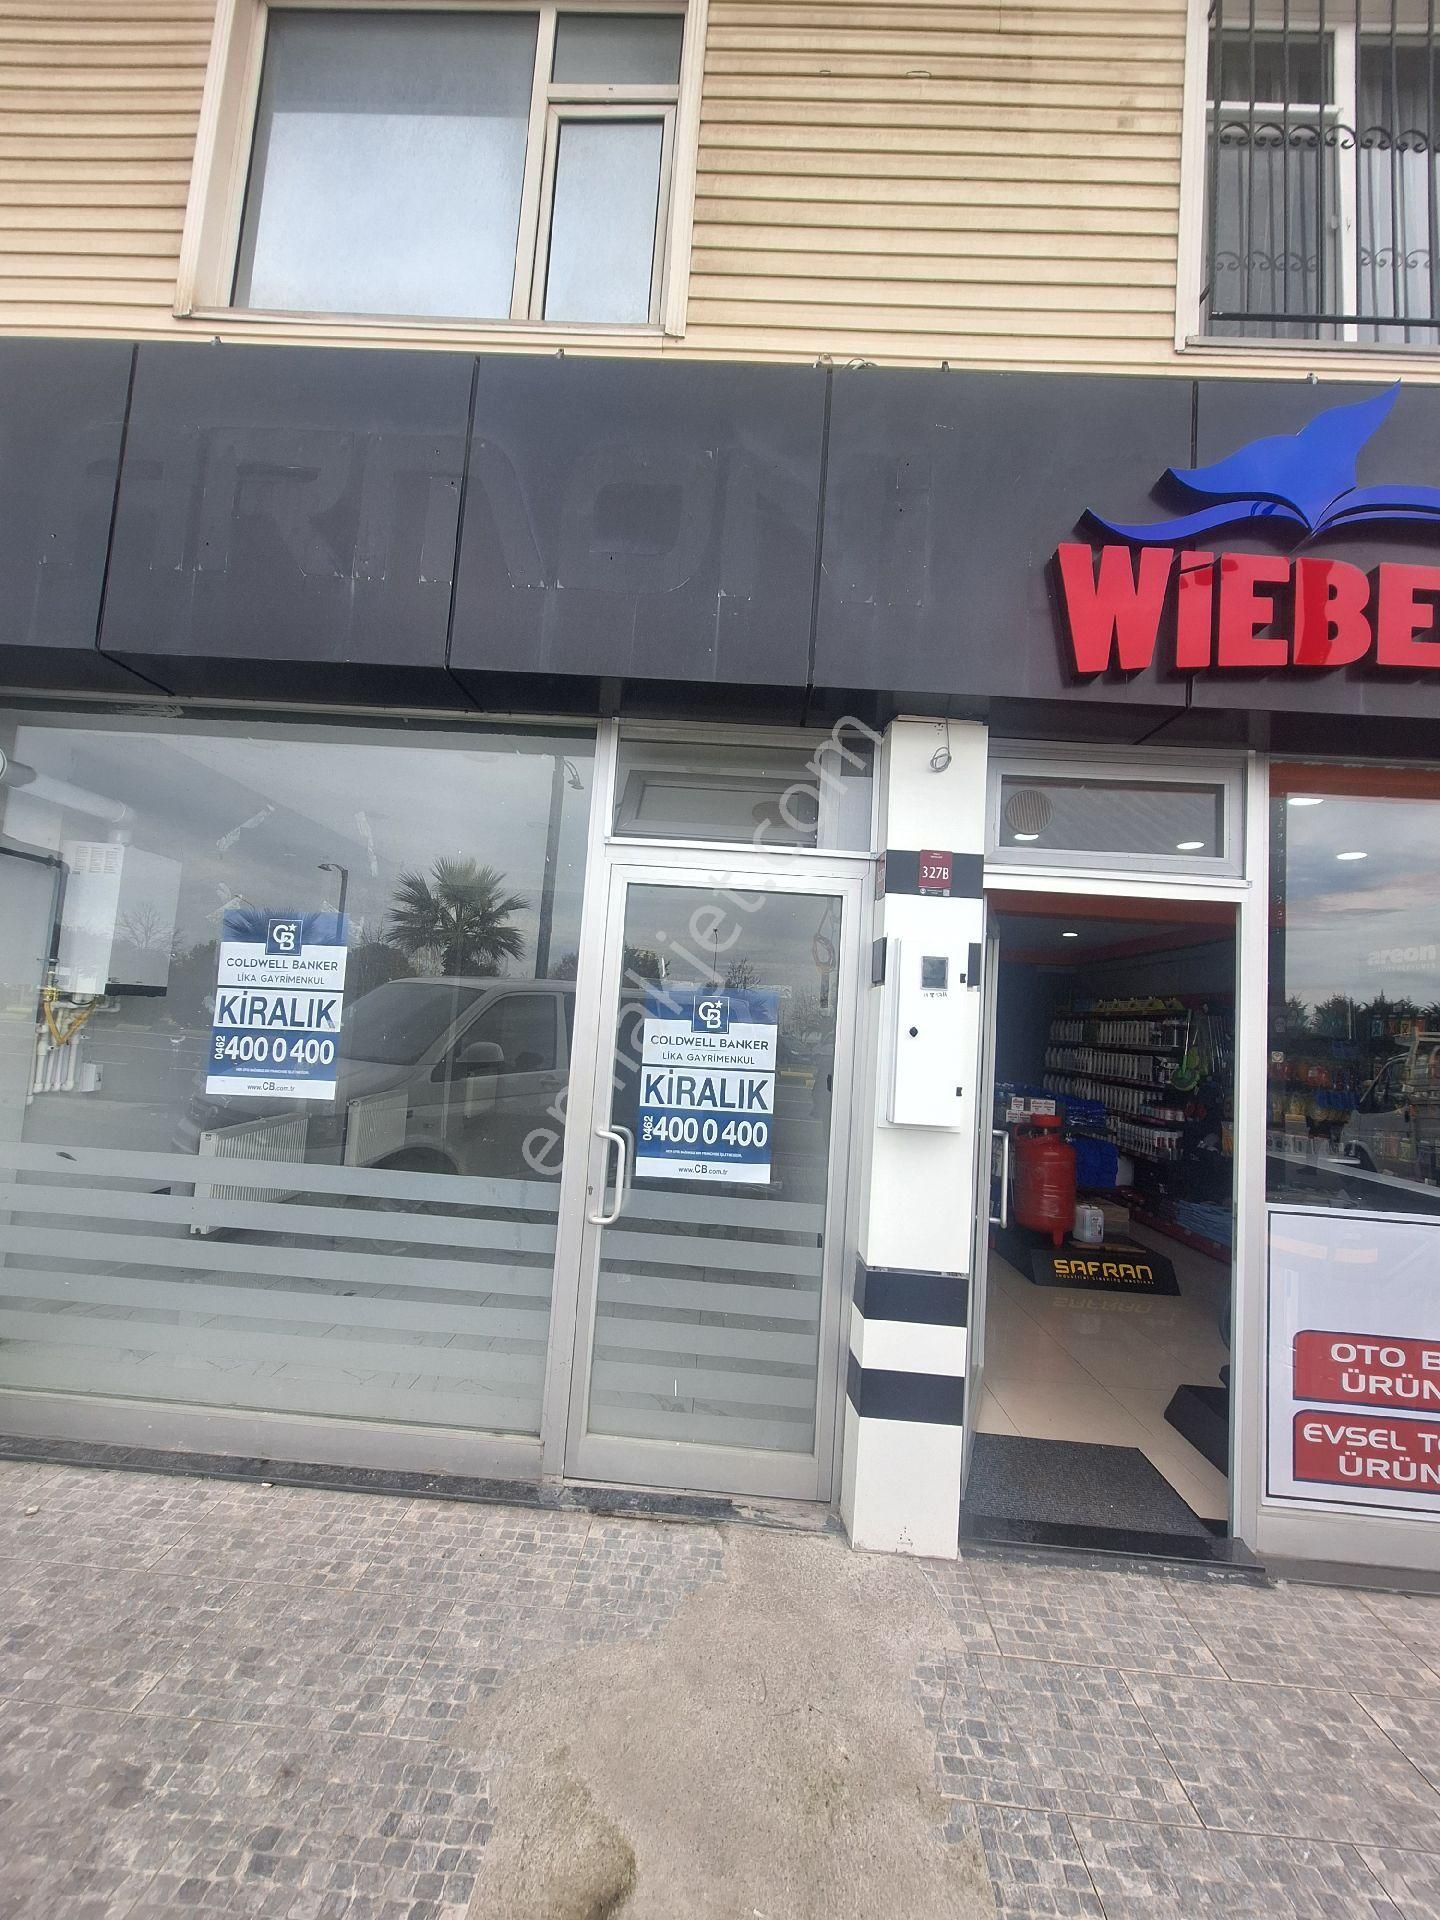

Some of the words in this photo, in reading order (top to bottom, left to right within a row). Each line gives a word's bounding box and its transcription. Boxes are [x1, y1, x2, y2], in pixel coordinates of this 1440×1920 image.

[922, 866, 949, 880] 327B
[226, 957, 289, 970] COLDWELL
[292, 960, 338, 971] BANKER
[237, 972, 257, 982] LİKA
[261, 974, 325, 985] GAYRİMENKUL
[218, 991, 337, 1029] KİRALIK
[214, 1035, 226, 1060] 0462
[225, 1036, 269, 1062] 400
[272, 1037, 287, 1063] 0
[290, 1038, 335, 1065] 400
[650, 1034, 716, 1048] COLDWELL
[719, 1038, 769, 1051] BANKER
[662, 1051, 683, 1061] LİKA
[687, 1053, 755, 1065] GAYRİMENKUL
[247, 1081, 295, 1093] www.CB.com.tr
[644, 1069, 768, 1111] KİRALIK
[643, 1115, 654, 1141] 0462
[653, 1116, 699, 1143] 400
[702, 1118, 718, 1146] 0
[721, 1120, 768, 1148] 400
[678, 1165, 728, 1176] www.CB.com.tr
[1053, 1259, 1153, 1280] SAFRAN
[1330, 1343, 1406, 1368] OTO
[1341, 1368, 1440, 1400] ÜRÜN
[1303, 1423, 1407, 1451] EVSEL
[1417, 1432, 1440, 1453] T
[1339, 1451, 1440, 1484] ÜRÜN
